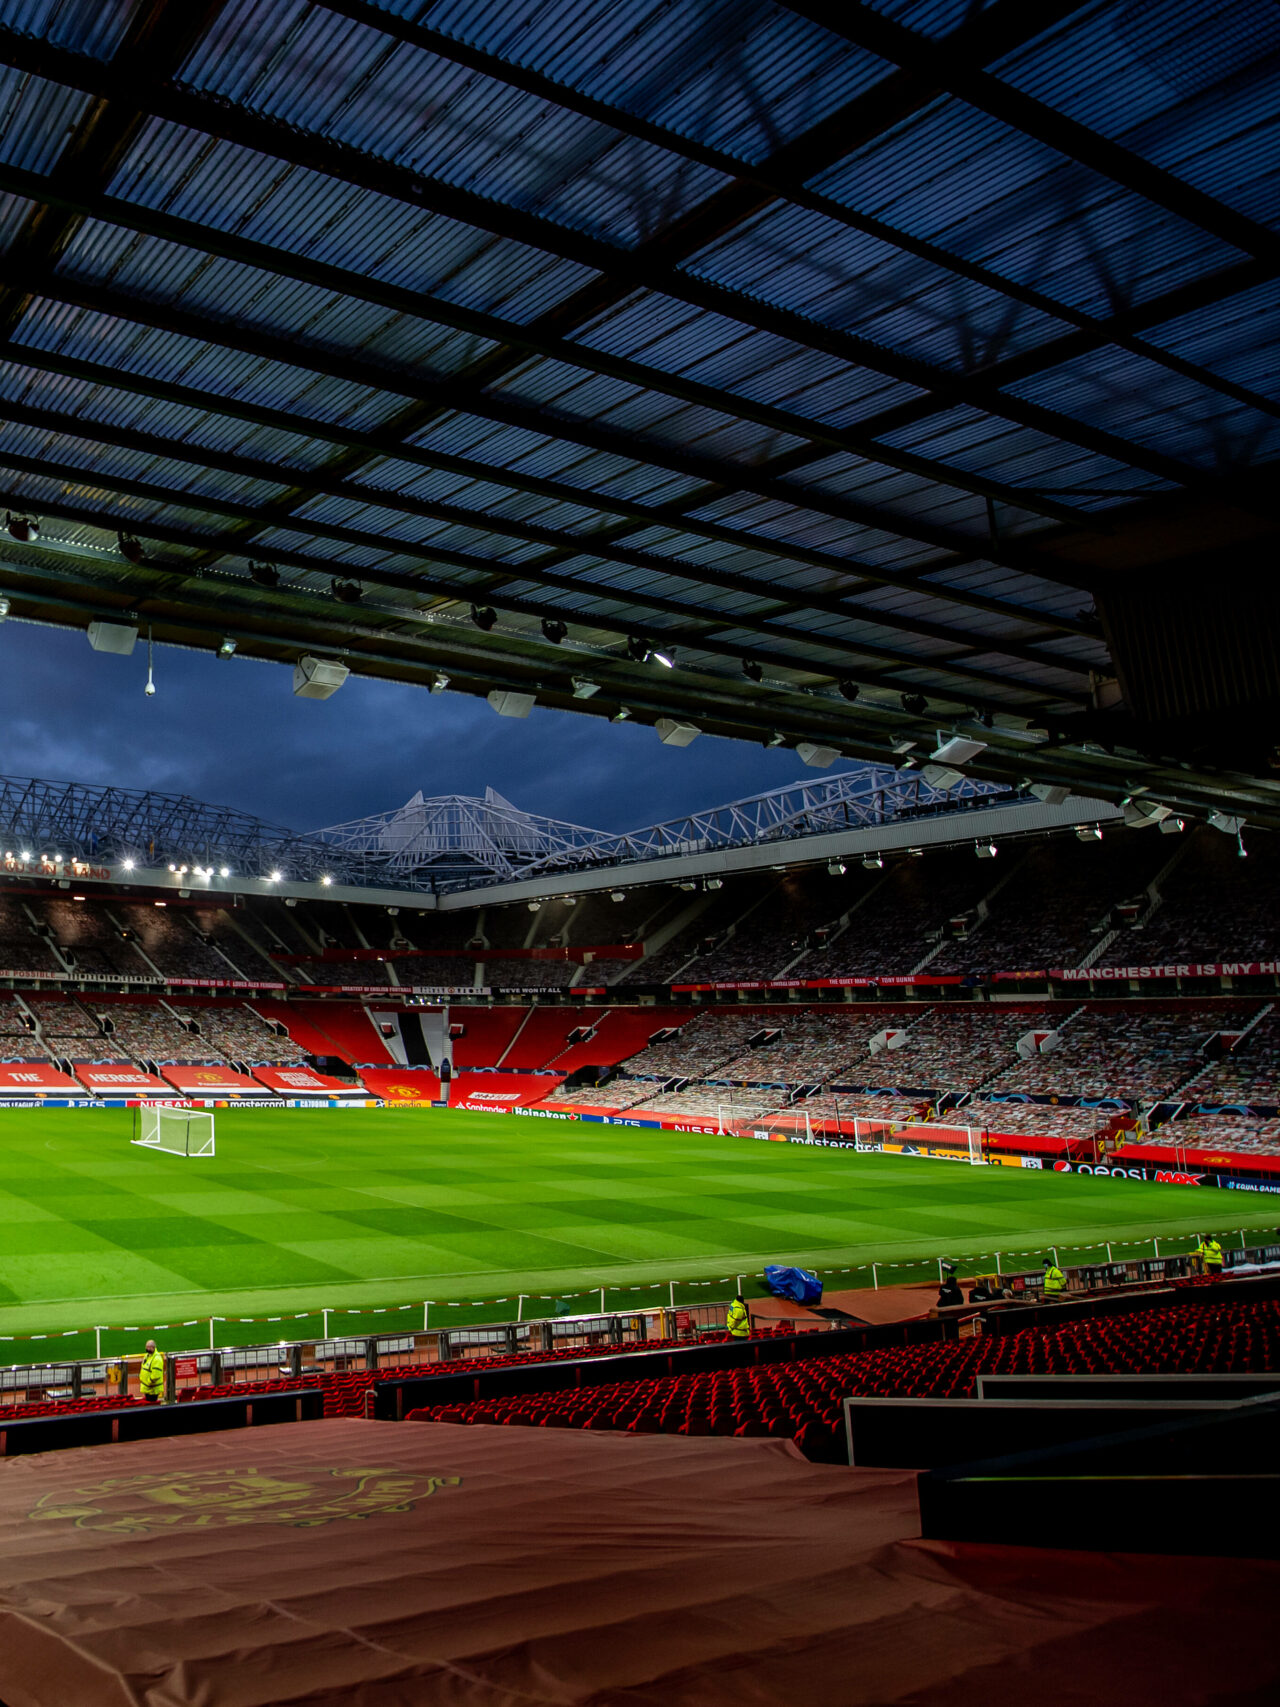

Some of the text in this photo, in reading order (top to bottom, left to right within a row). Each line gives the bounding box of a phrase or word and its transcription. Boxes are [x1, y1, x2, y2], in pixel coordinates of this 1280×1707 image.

[63, 863, 111, 880] STAND
[1063, 965, 1190, 980] MANCHESTER
[1197, 964, 1216, 976] IS
[1222, 963, 1253, 975] MY
[8, 1073, 44, 1082] THE
[88, 1074, 151, 1083] HEROES
[465, 1102, 508, 1114] Santander
[515, 1107, 567, 1120] Heineken
[1154, 1170, 1206, 1186] MAX
